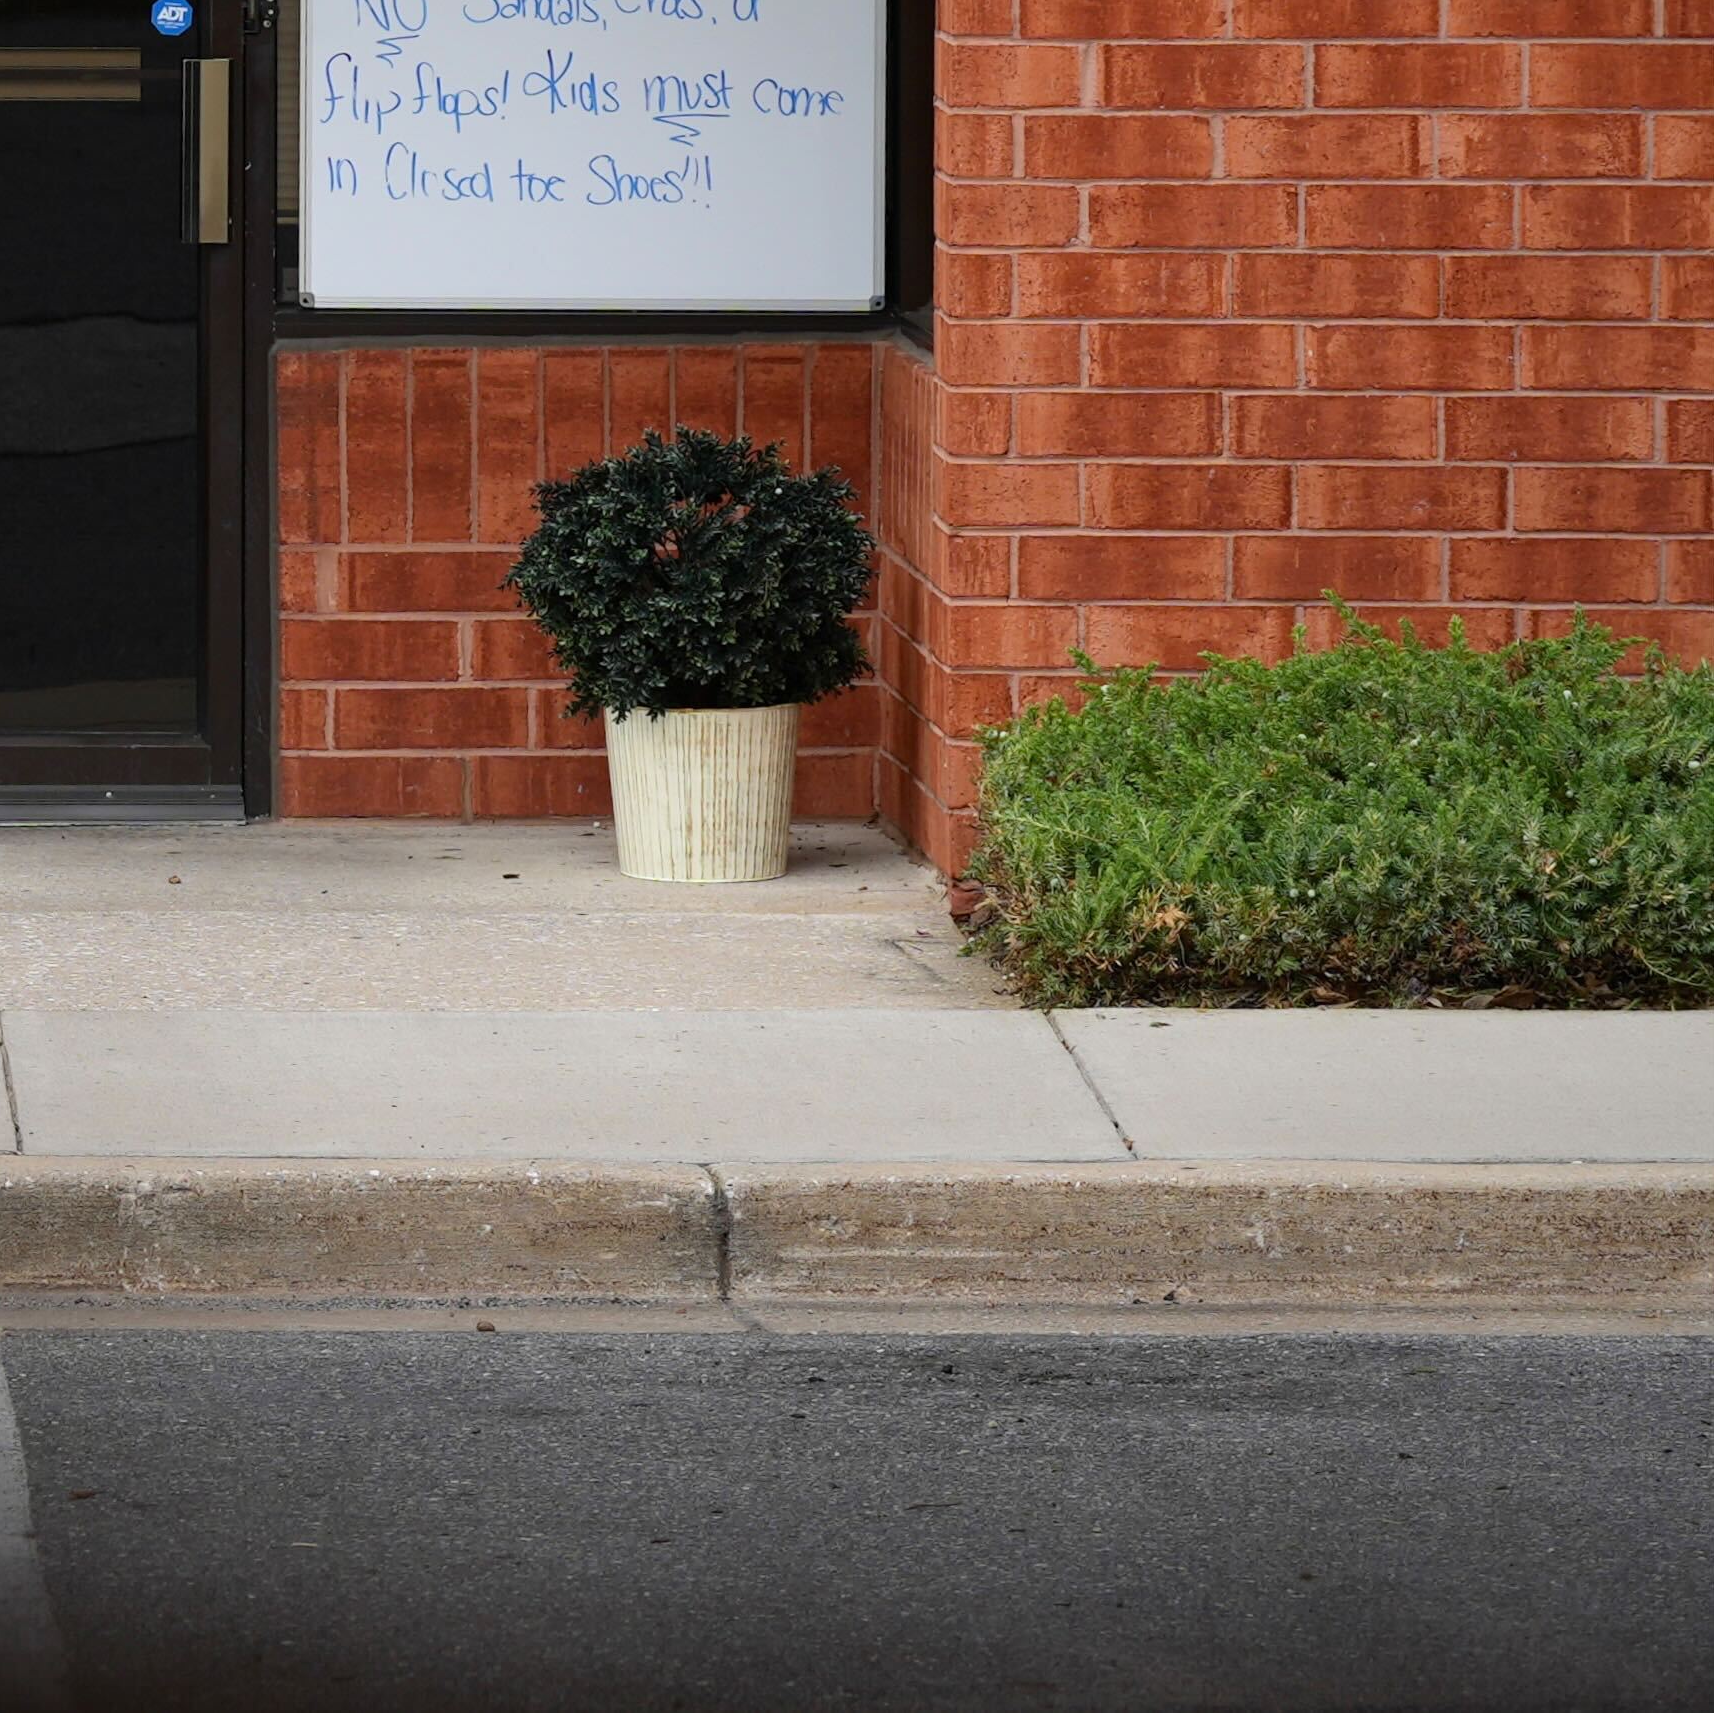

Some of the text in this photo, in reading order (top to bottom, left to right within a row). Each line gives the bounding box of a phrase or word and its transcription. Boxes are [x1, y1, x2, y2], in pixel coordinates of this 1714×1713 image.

[157, 6, 188, 22] ADT
[643, 69, 733, 115] must
[510, 158, 566, 202] toe
